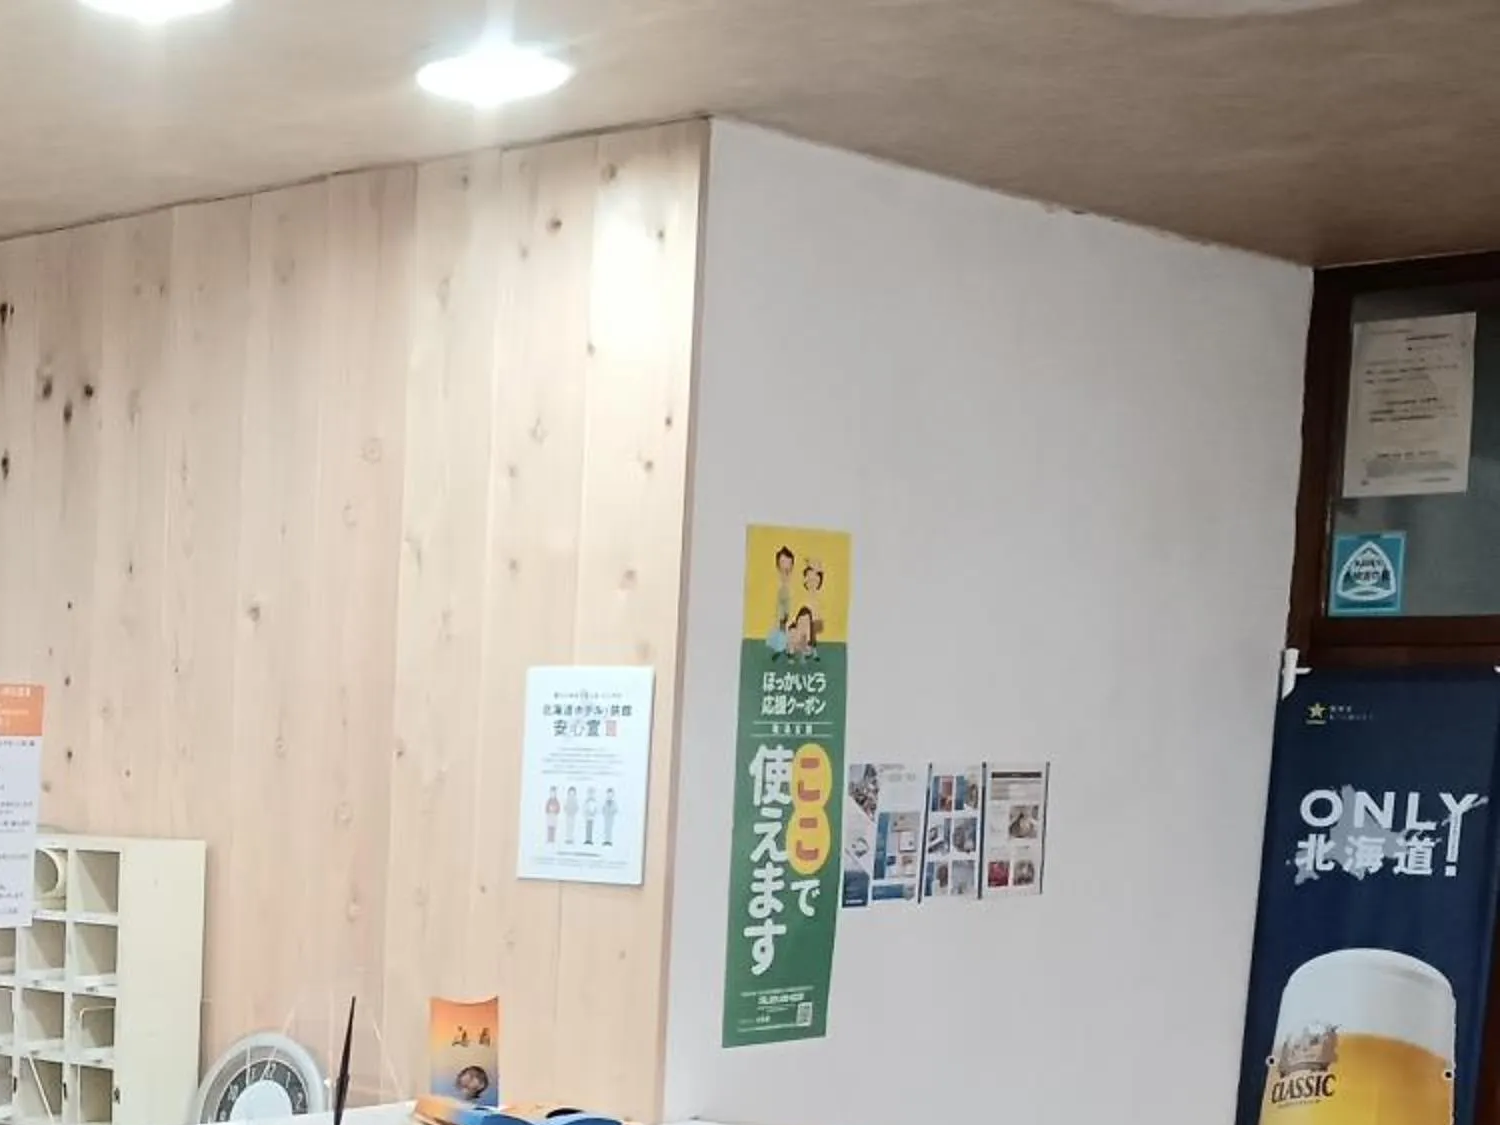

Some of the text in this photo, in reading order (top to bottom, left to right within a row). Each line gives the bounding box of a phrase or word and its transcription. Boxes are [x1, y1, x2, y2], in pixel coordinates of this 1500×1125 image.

[763, 671, 827, 693] ほっかいどう
[789, 757, 822, 917] ここで
[1300, 789, 1479, 850] ONLY
[743, 744, 794, 976] 使えます
[1271, 1073, 1337, 1105] CLASSIC
